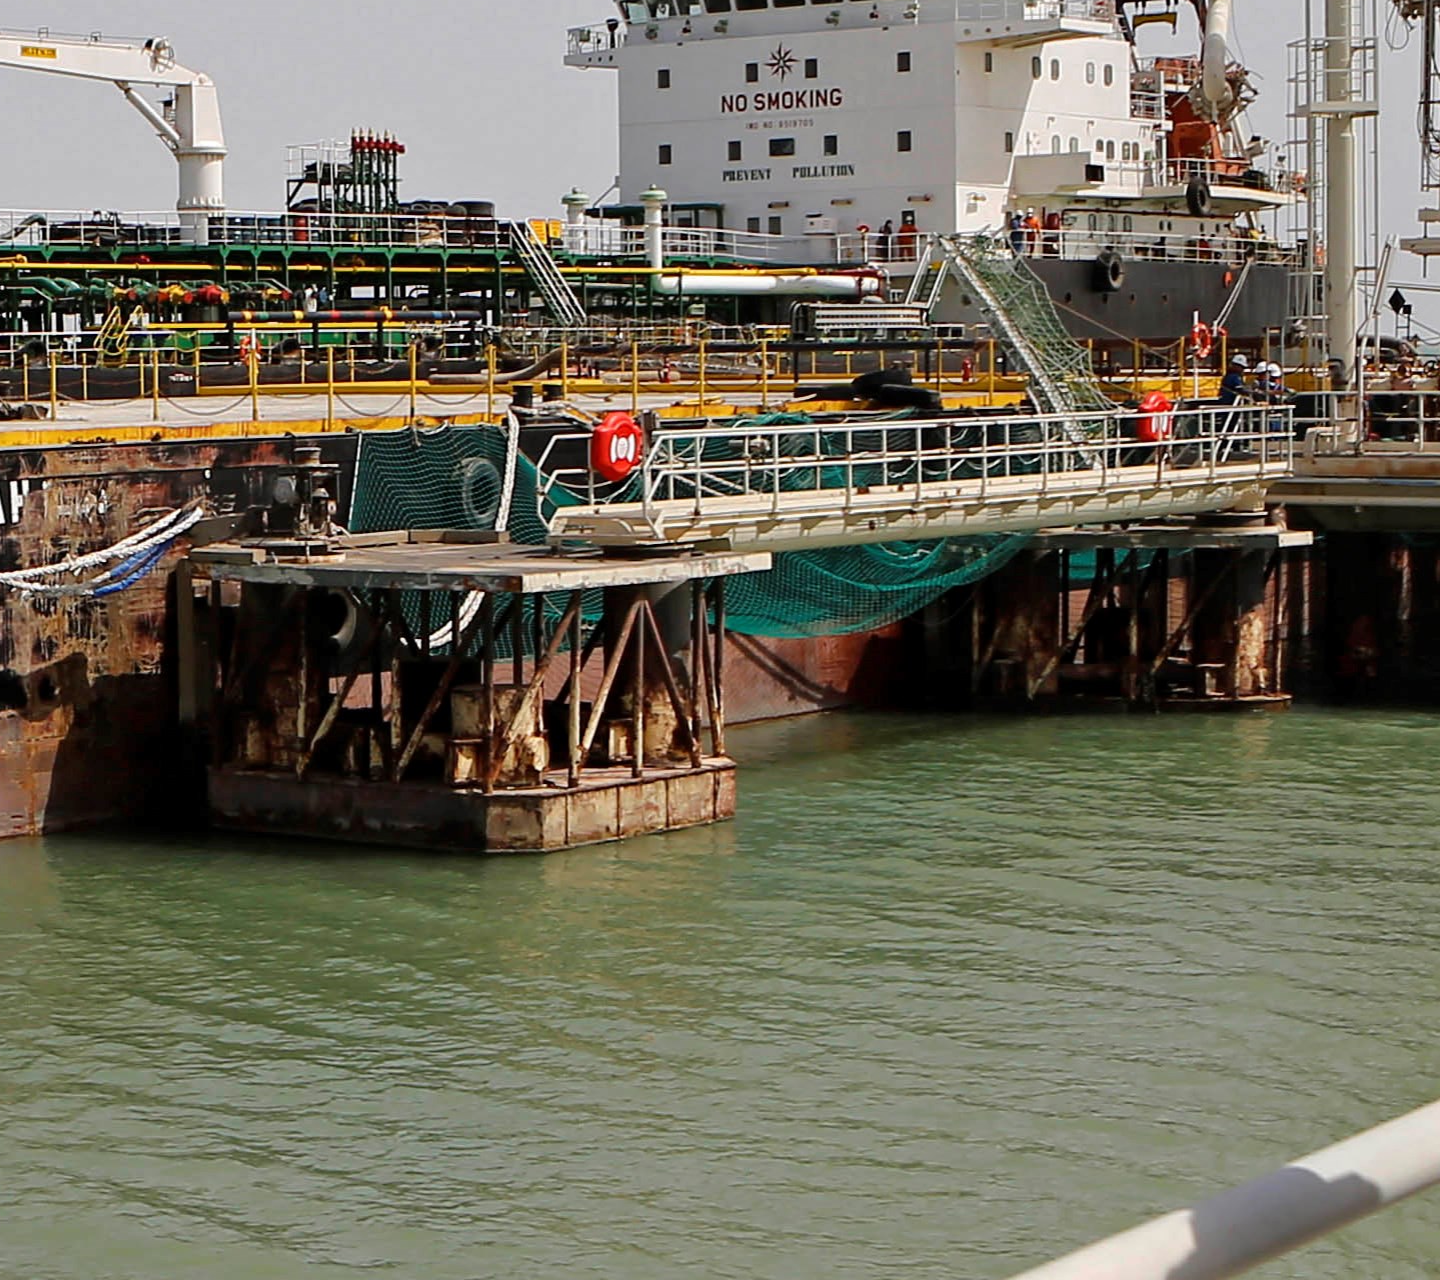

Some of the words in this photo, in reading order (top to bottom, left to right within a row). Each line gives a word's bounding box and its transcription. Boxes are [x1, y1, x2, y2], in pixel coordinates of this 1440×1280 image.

[721, 94, 748, 113] NO
[753, 88, 843, 111] SMOKING
[722, 168, 771, 182] PREVENT
[792, 164, 855, 179] POLLUTION
